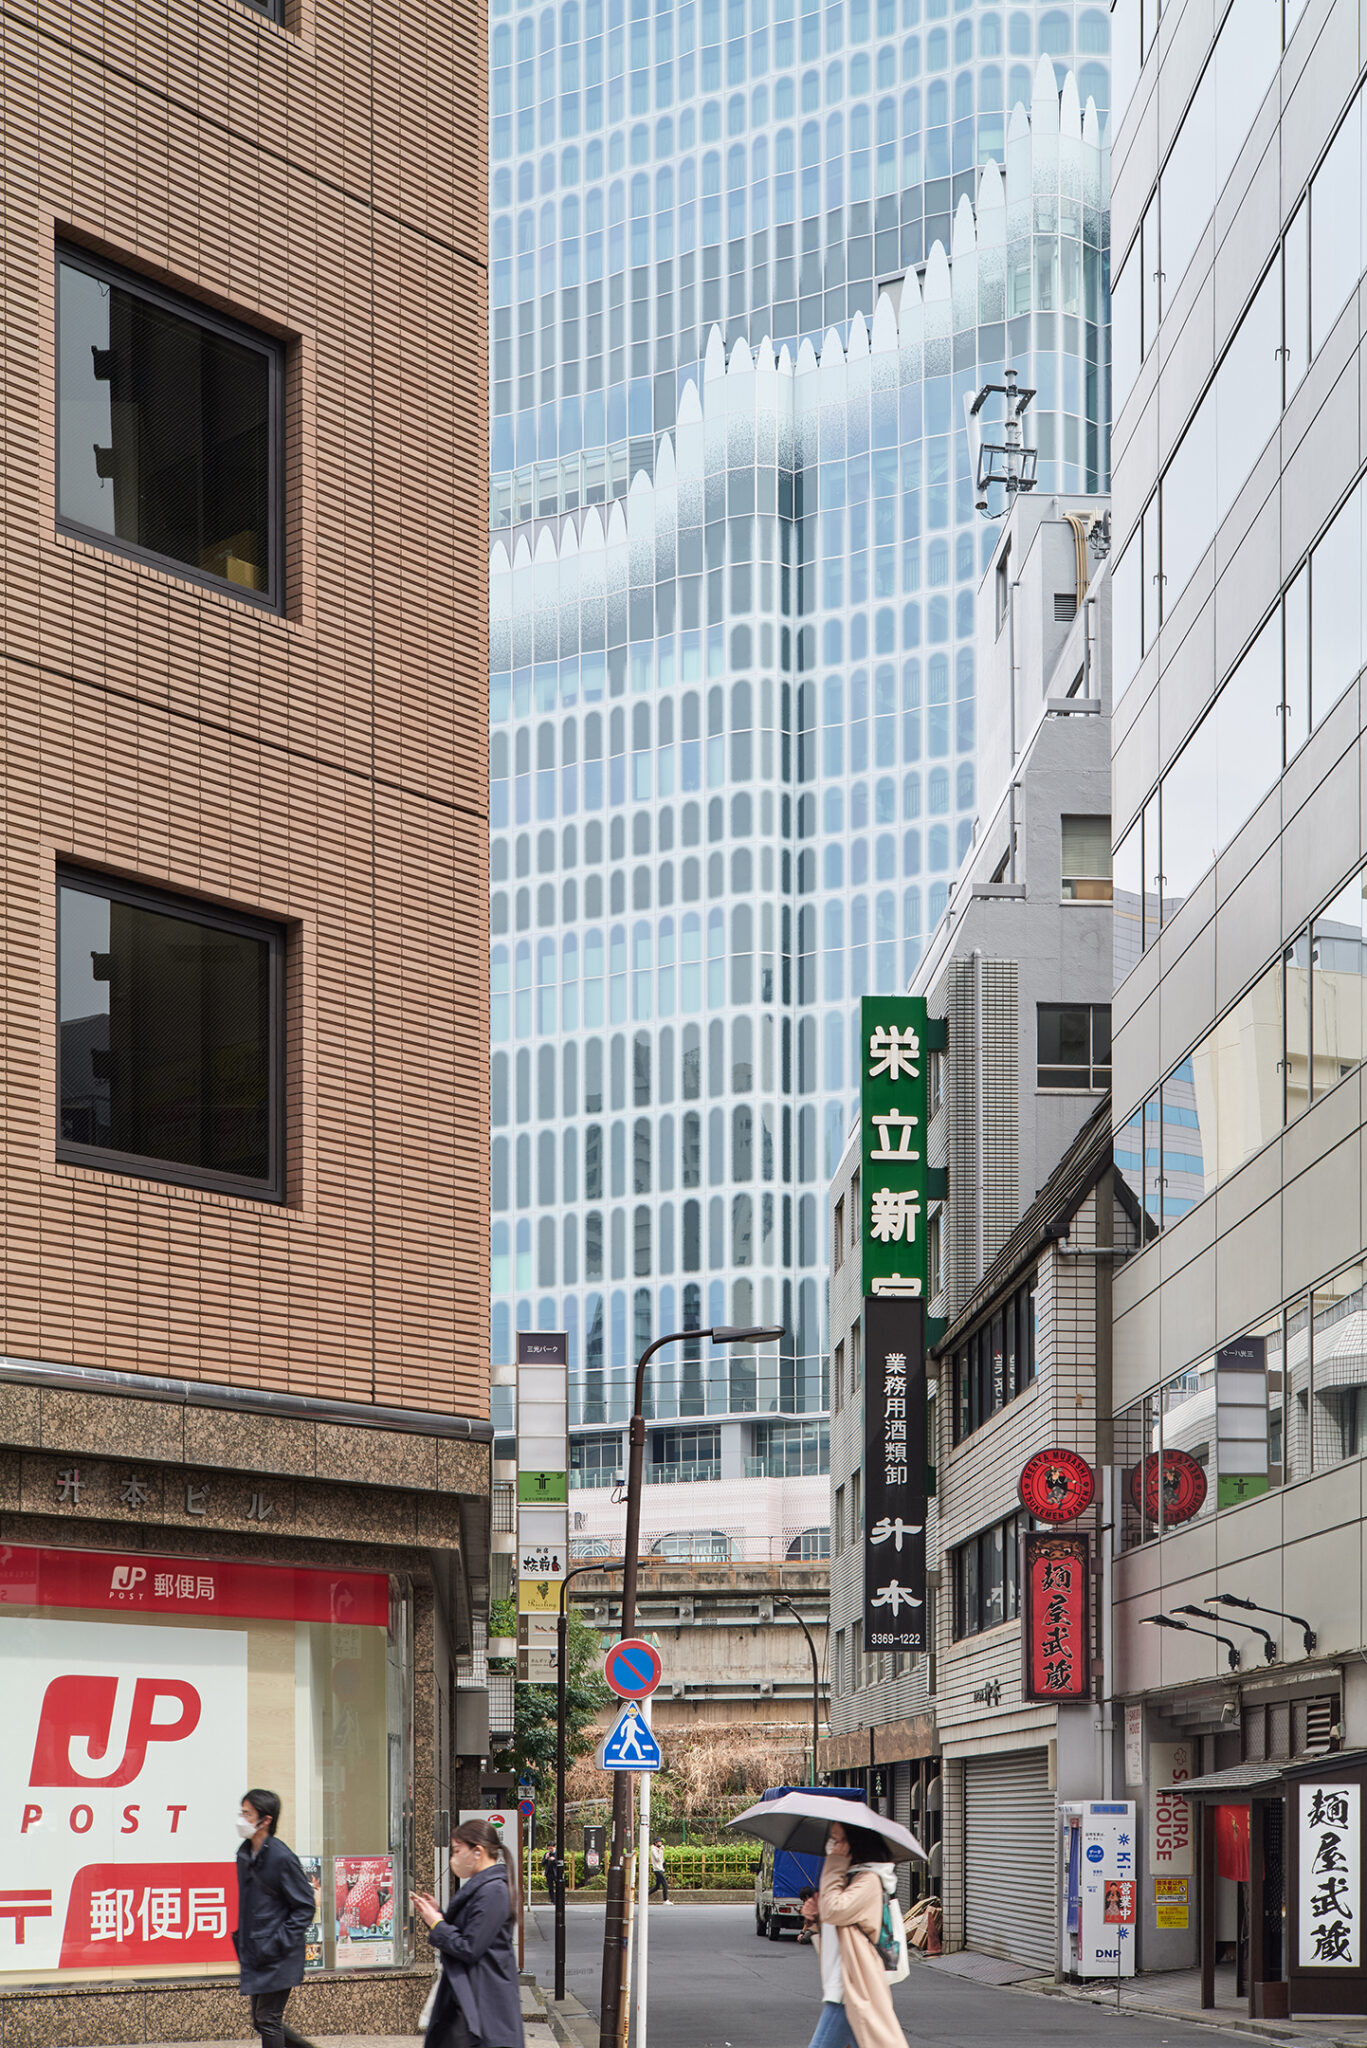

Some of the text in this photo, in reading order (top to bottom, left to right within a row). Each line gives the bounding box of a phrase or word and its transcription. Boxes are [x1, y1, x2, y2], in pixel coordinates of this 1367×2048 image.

[883, 1353, 907, 1485] 業務用酒類卸
[1025, 1452, 1088, 1479] MENYA MUSASHI
[57, 1469, 273, 1520] 升本ビル
[1025, 1490, 1089, 1519] TSUKEMEN RAMEN
[111, 1566, 146, 1590] JP
[154, 1573, 215, 1600] 郵便局
[870, 1517, 923, 1617] 升本
[109, 1591, 144, 1600] POST
[871, 1633, 921, 1645] 3369-1222
[1041, 1562, 1074, 1692] 麺屋武蔵
[29, 1675, 201, 1788] JP
[20, 1804, 188, 1834] POST
[1156, 1793, 1172, 1861] HOUSE
[1172, 1769, 1188, 1850] SKURA
[1307, 1788, 1353, 1963] 麺屋武蔵
[90, 1887, 227, 1943] 郵便局
[1119, 1882, 1133, 1920] 営業中
[1096, 1949, 1121, 1958] DNP
